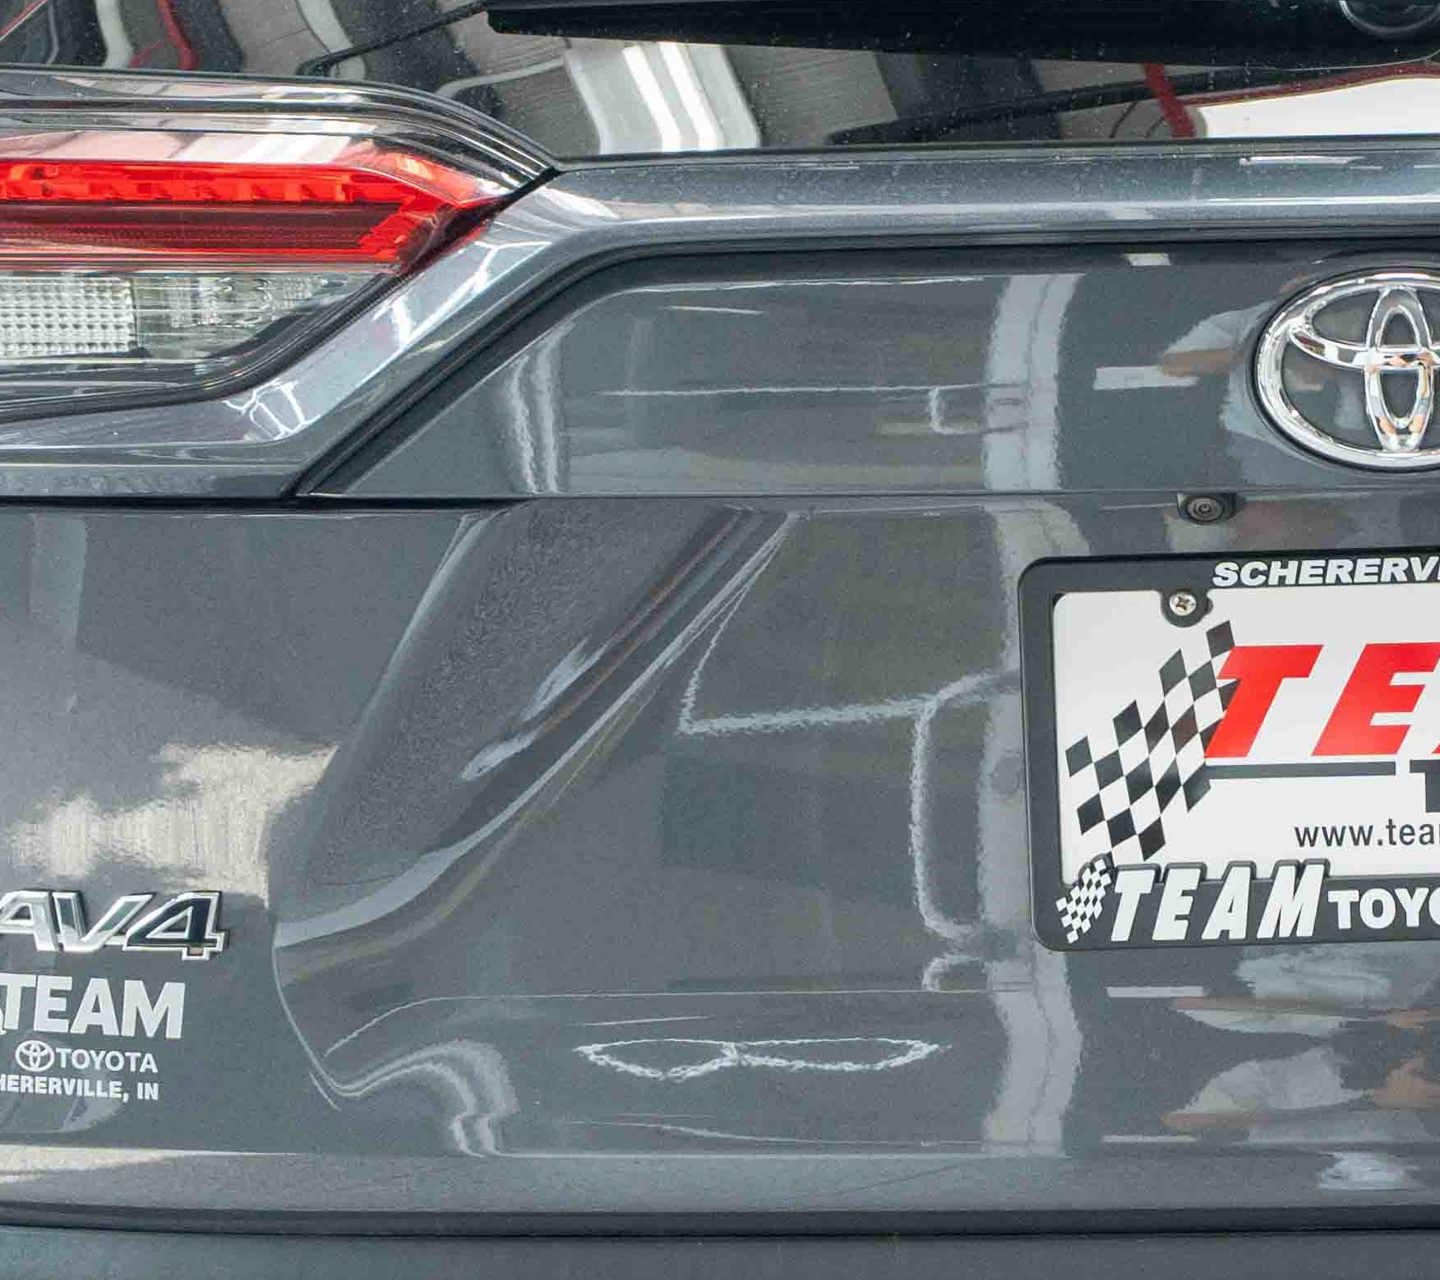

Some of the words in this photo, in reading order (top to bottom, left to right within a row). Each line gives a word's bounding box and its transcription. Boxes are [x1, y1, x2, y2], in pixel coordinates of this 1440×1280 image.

[1111, 861, 1329, 942] TEAM
[55, 1048, 159, 1074] TOYOTA
[136, 1080, 160, 1101] IN
